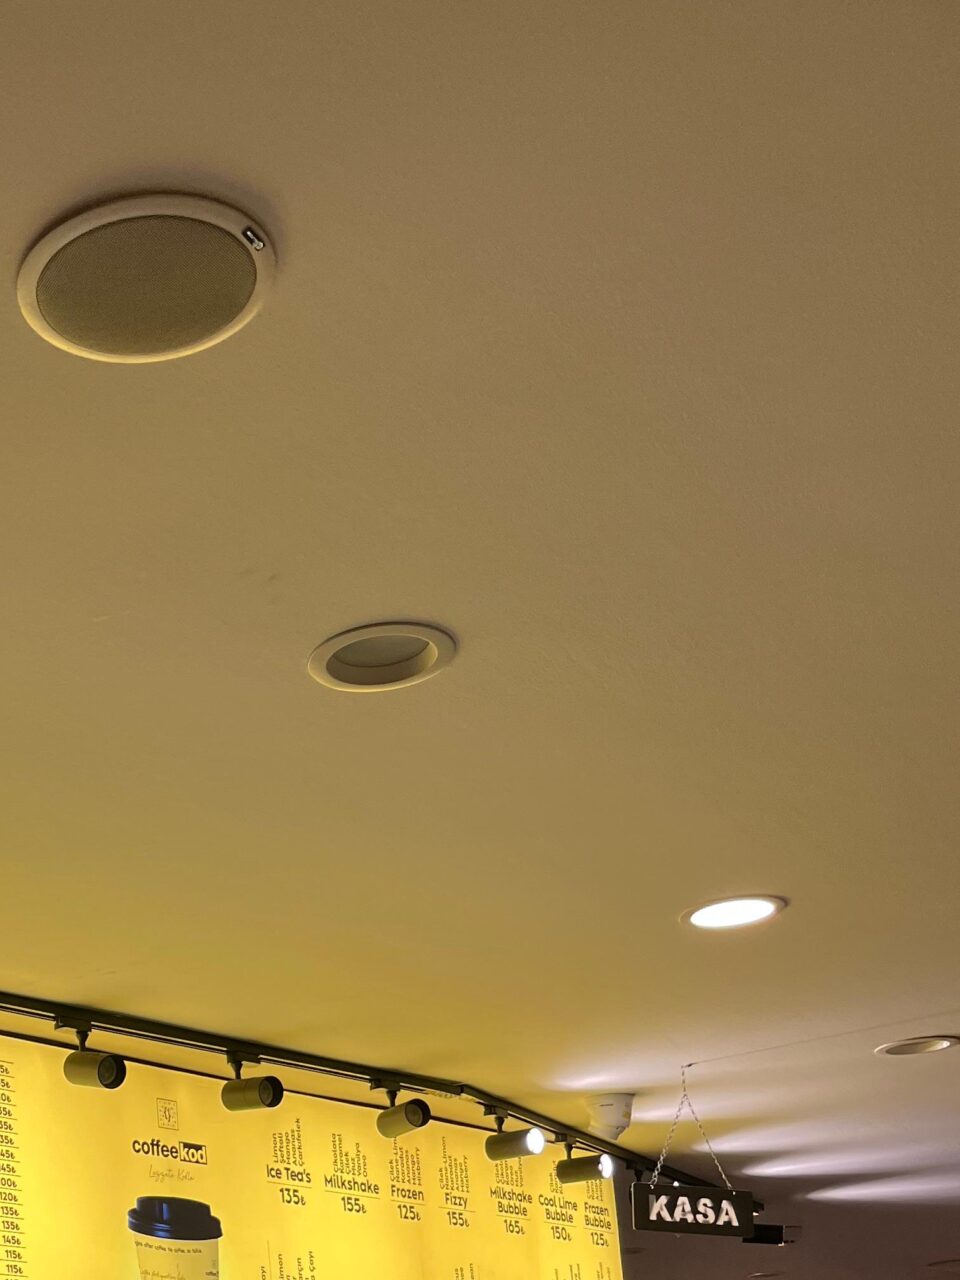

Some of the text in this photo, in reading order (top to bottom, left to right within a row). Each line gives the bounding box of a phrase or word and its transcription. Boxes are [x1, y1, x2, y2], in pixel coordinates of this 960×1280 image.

[266, 1164, 312, 1184] Ice Tea's
[324, 1174, 380, 1195] Milkshake
[391, 1184, 425, 1201] Frozen
[444, 1191, 468, 1210] Fizzy
[489, 1187, 533, 1204] Milkshake
[538, 1194, 578, 1211] Cool Lime
[497, 1201, 528, 1217] Bubble
[545, 1208, 574, 1224] Bubble
[584, 1202, 610, 1217] Frozen
[648, 1194, 740, 1227] KASA
[585, 1215, 612, 1230] Bubble
